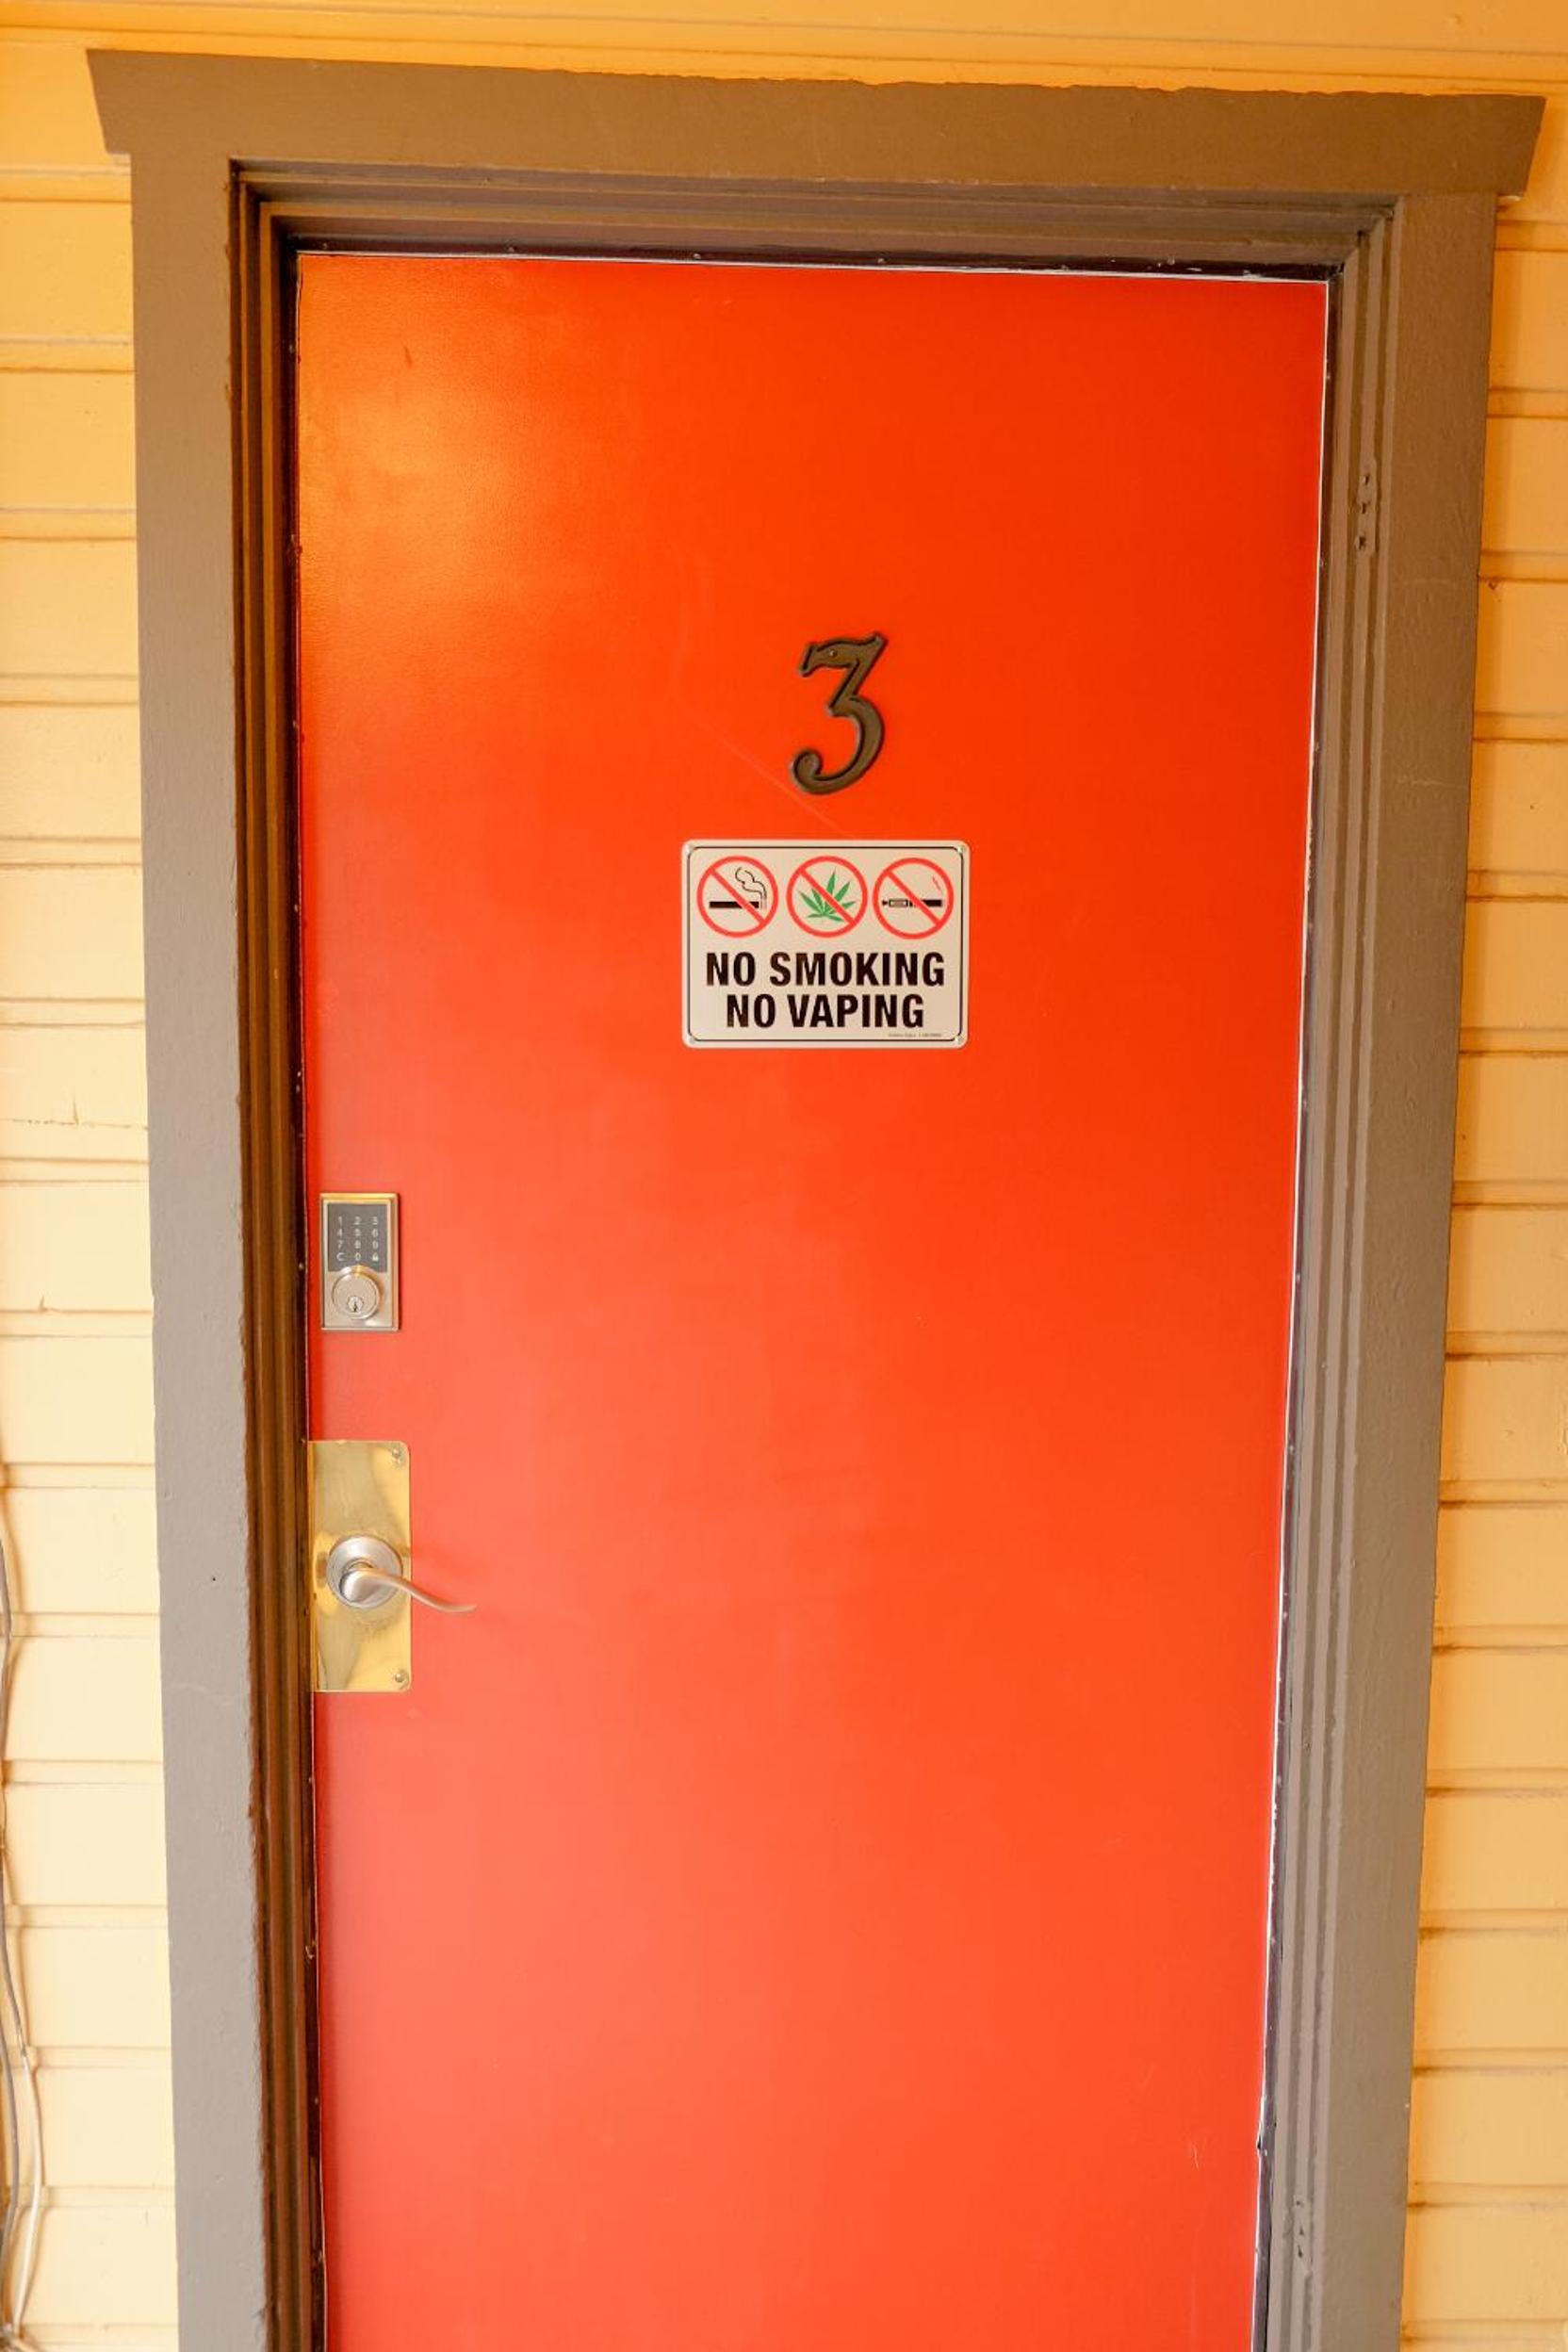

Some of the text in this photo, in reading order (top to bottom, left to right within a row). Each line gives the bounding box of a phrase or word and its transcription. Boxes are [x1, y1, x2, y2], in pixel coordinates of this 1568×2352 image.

[792, 631, 889, 794] 3
[706, 952, 945, 987] NO SMOKING
[727, 993, 924, 1029] NO VAPING
[354, 1217, 362, 1226] 2
[337, 1240, 344, 1250] 7
[336, 1252, 345, 1262] C
